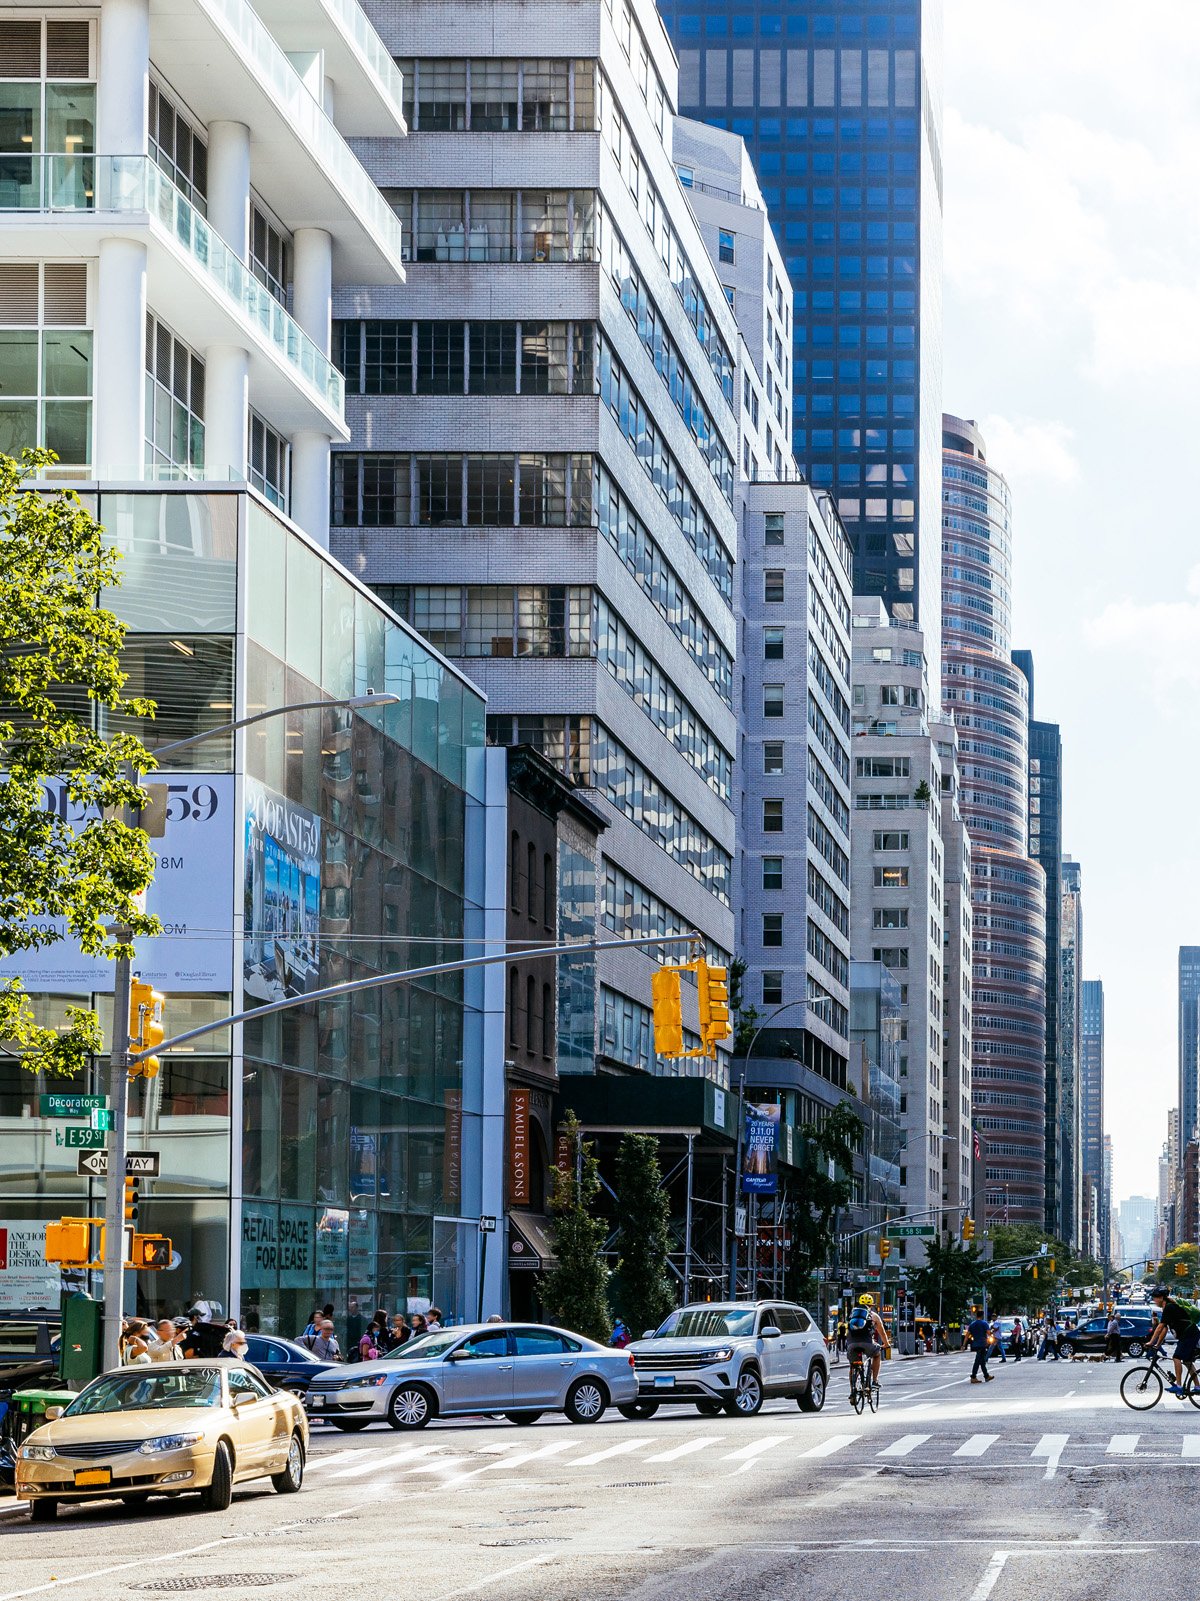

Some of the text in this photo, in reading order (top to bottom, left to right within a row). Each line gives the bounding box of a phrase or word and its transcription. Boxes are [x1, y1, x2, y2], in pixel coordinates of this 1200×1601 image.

[49, 1097, 100, 1107] Decorators
[101, 1112, 106, 1128] 3
[515, 1097, 524, 1149] SAMUEL
[750, 1127, 775, 1135] 9.11.01
[69, 1130, 102, 1145] E 59 St
[750, 1136, 774, 1144] NEVER
[749, 1144, 775, 1152] FORGET
[90, 1158, 106, 1168] ON
[515, 1162, 524, 1197] SONS
[243, 1218, 276, 1242] RETAIL
[280, 1220, 308, 1244] SPACE
[9, 1241, 28, 1249] THE
[9, 1249, 41, 1258] DESIGN
[256, 1246, 308, 1270] FOR LEASE
[9, 1259, 48, 1268] DISTRICT
